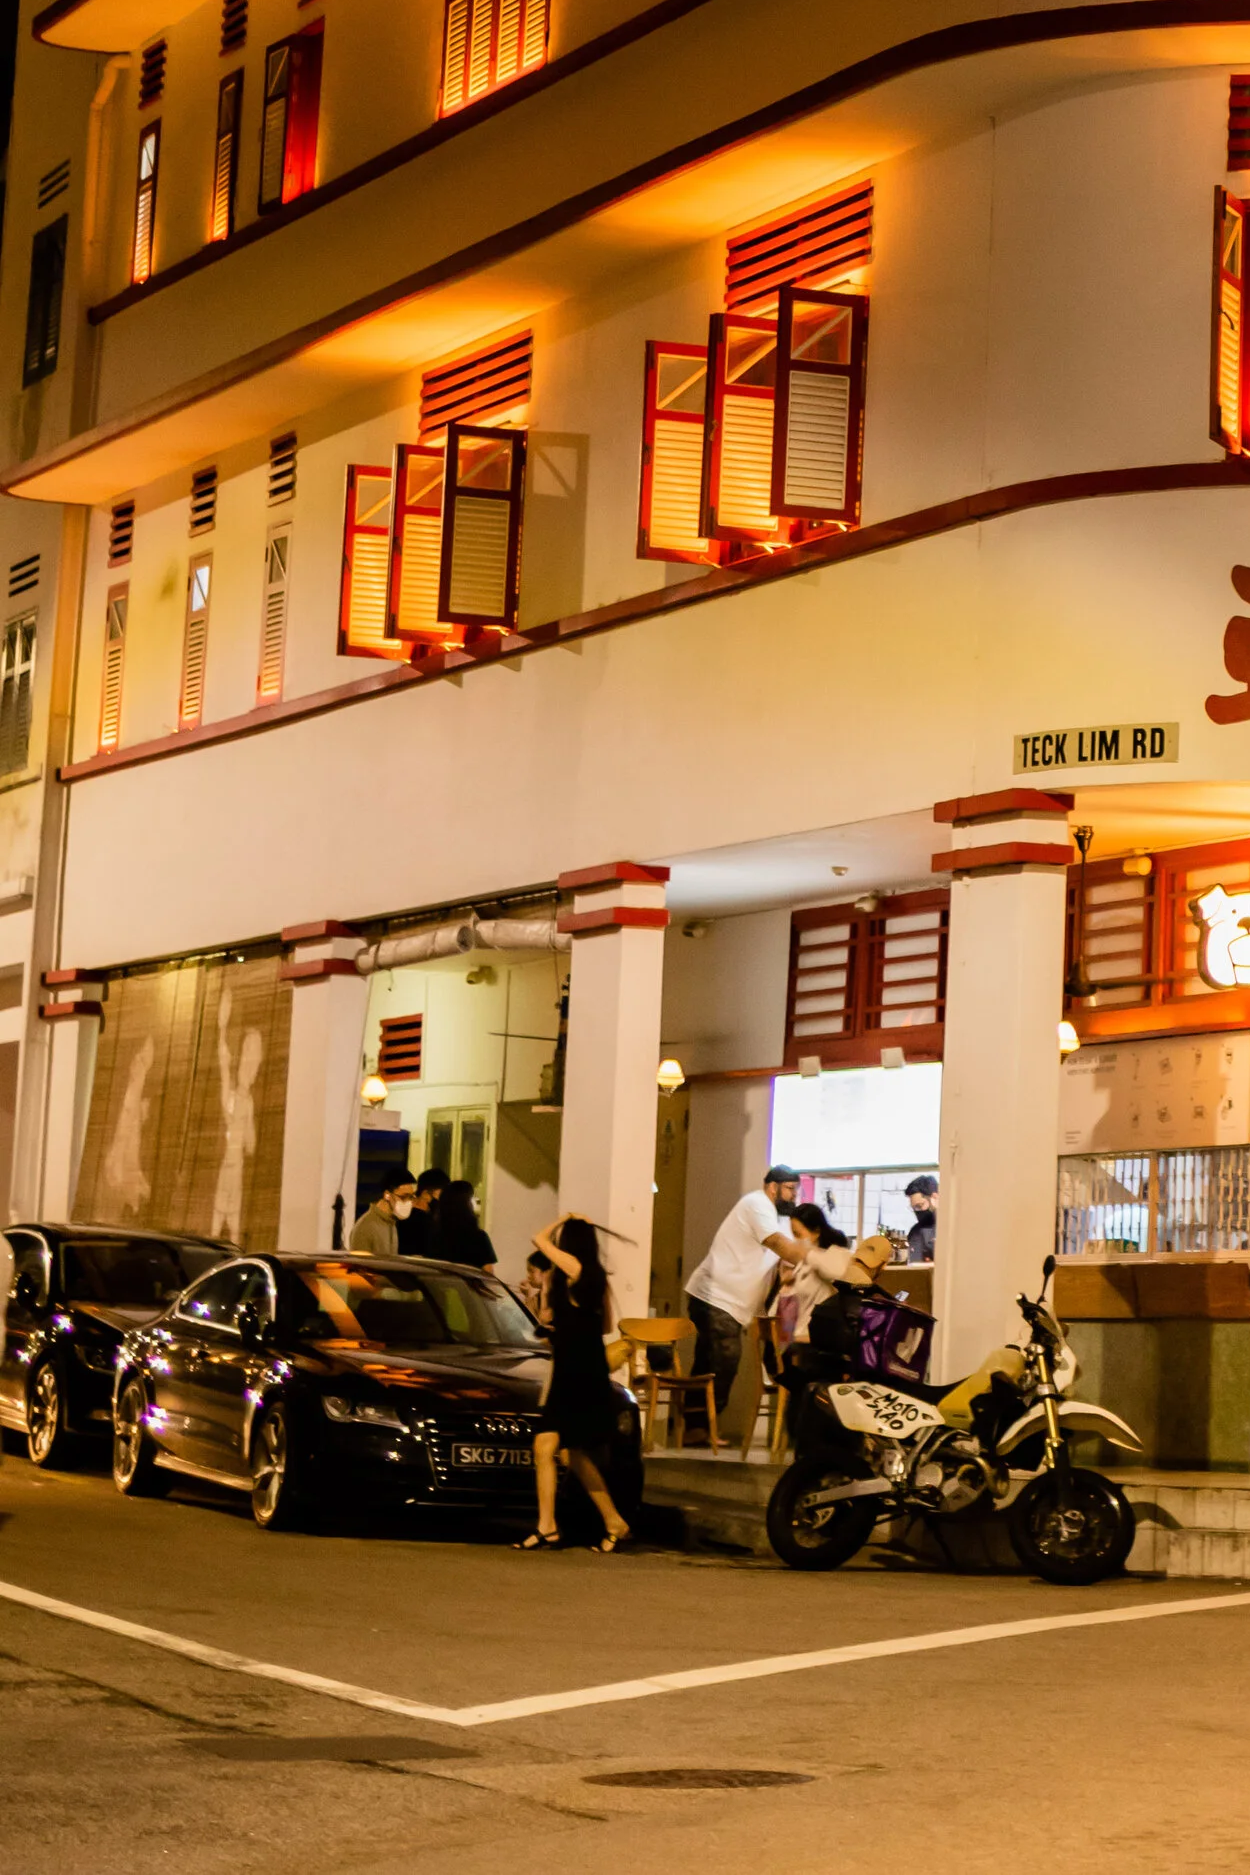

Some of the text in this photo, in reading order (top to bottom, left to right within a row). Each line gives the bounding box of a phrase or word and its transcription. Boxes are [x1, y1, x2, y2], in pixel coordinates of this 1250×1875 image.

[1021, 727, 1165, 768] TECK LIM RD
